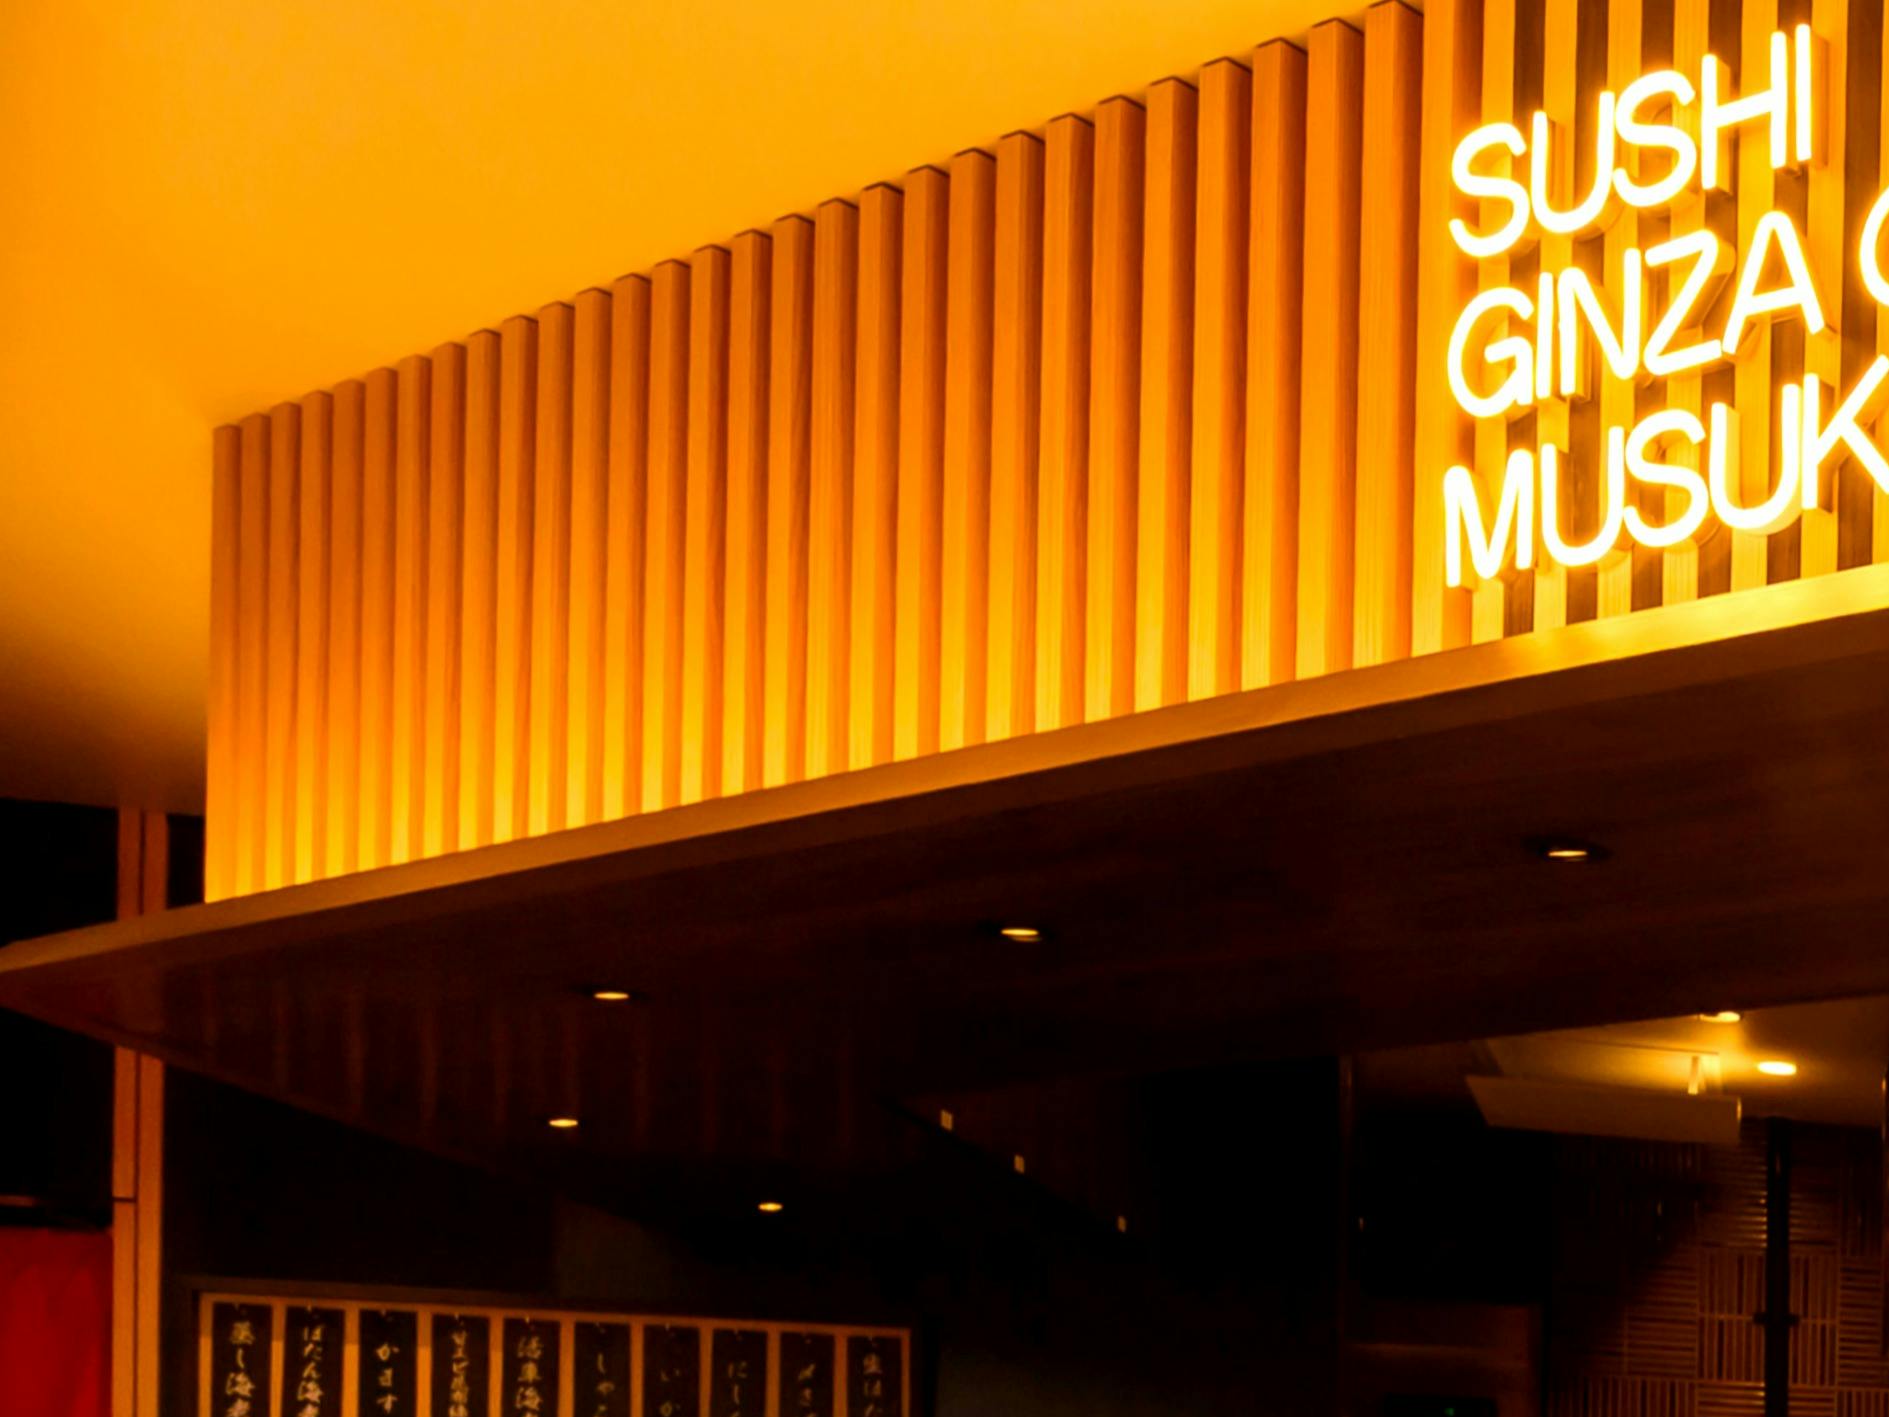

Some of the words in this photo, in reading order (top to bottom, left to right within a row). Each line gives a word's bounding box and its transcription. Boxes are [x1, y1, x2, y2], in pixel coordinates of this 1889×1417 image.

[1449, 24, 1813, 257] SUSHI
[1447, 211, 1826, 417] GINZA
[374, 1342, 400, 1415] かます
